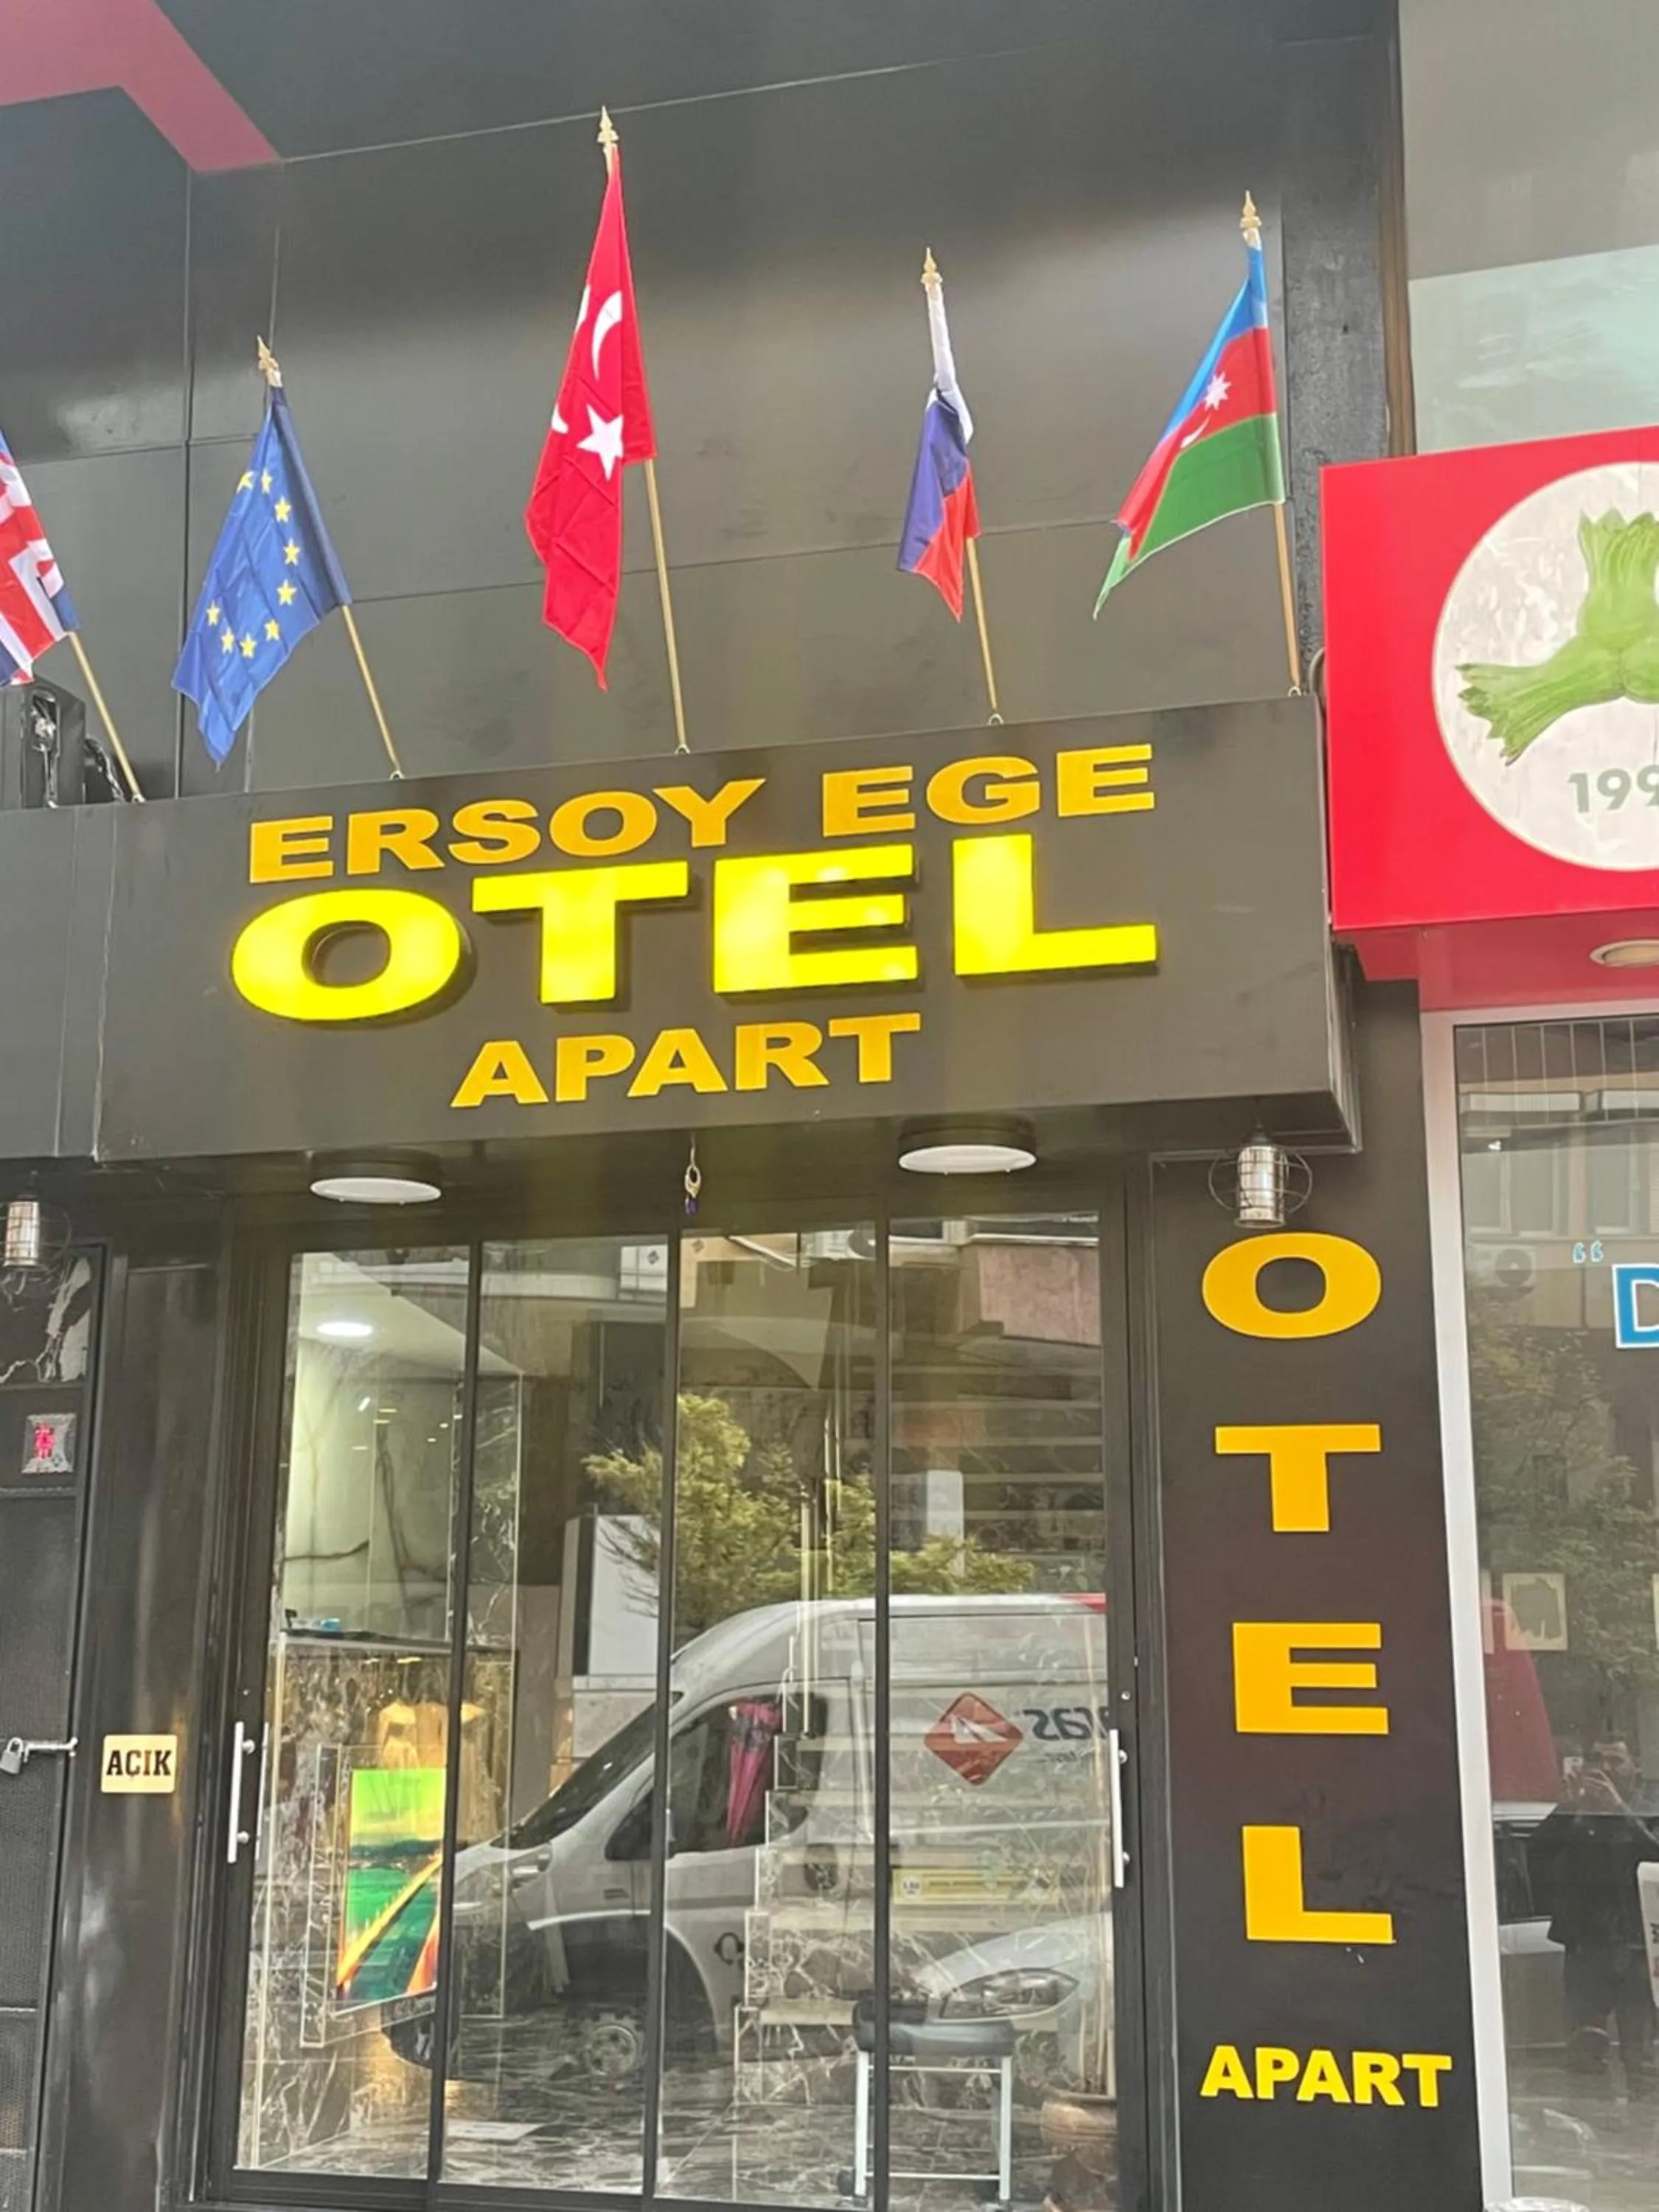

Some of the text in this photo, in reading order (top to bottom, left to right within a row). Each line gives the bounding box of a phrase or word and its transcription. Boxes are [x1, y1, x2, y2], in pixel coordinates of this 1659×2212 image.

[248, 743, 1155, 883] ERSOY EGE
[231, 833, 1158, 1021] OTEL
[451, 1012, 921, 1108] APART
[1202, 1232, 1394, 1944] OTEL
[1200, 2045, 1452, 2107] APART
